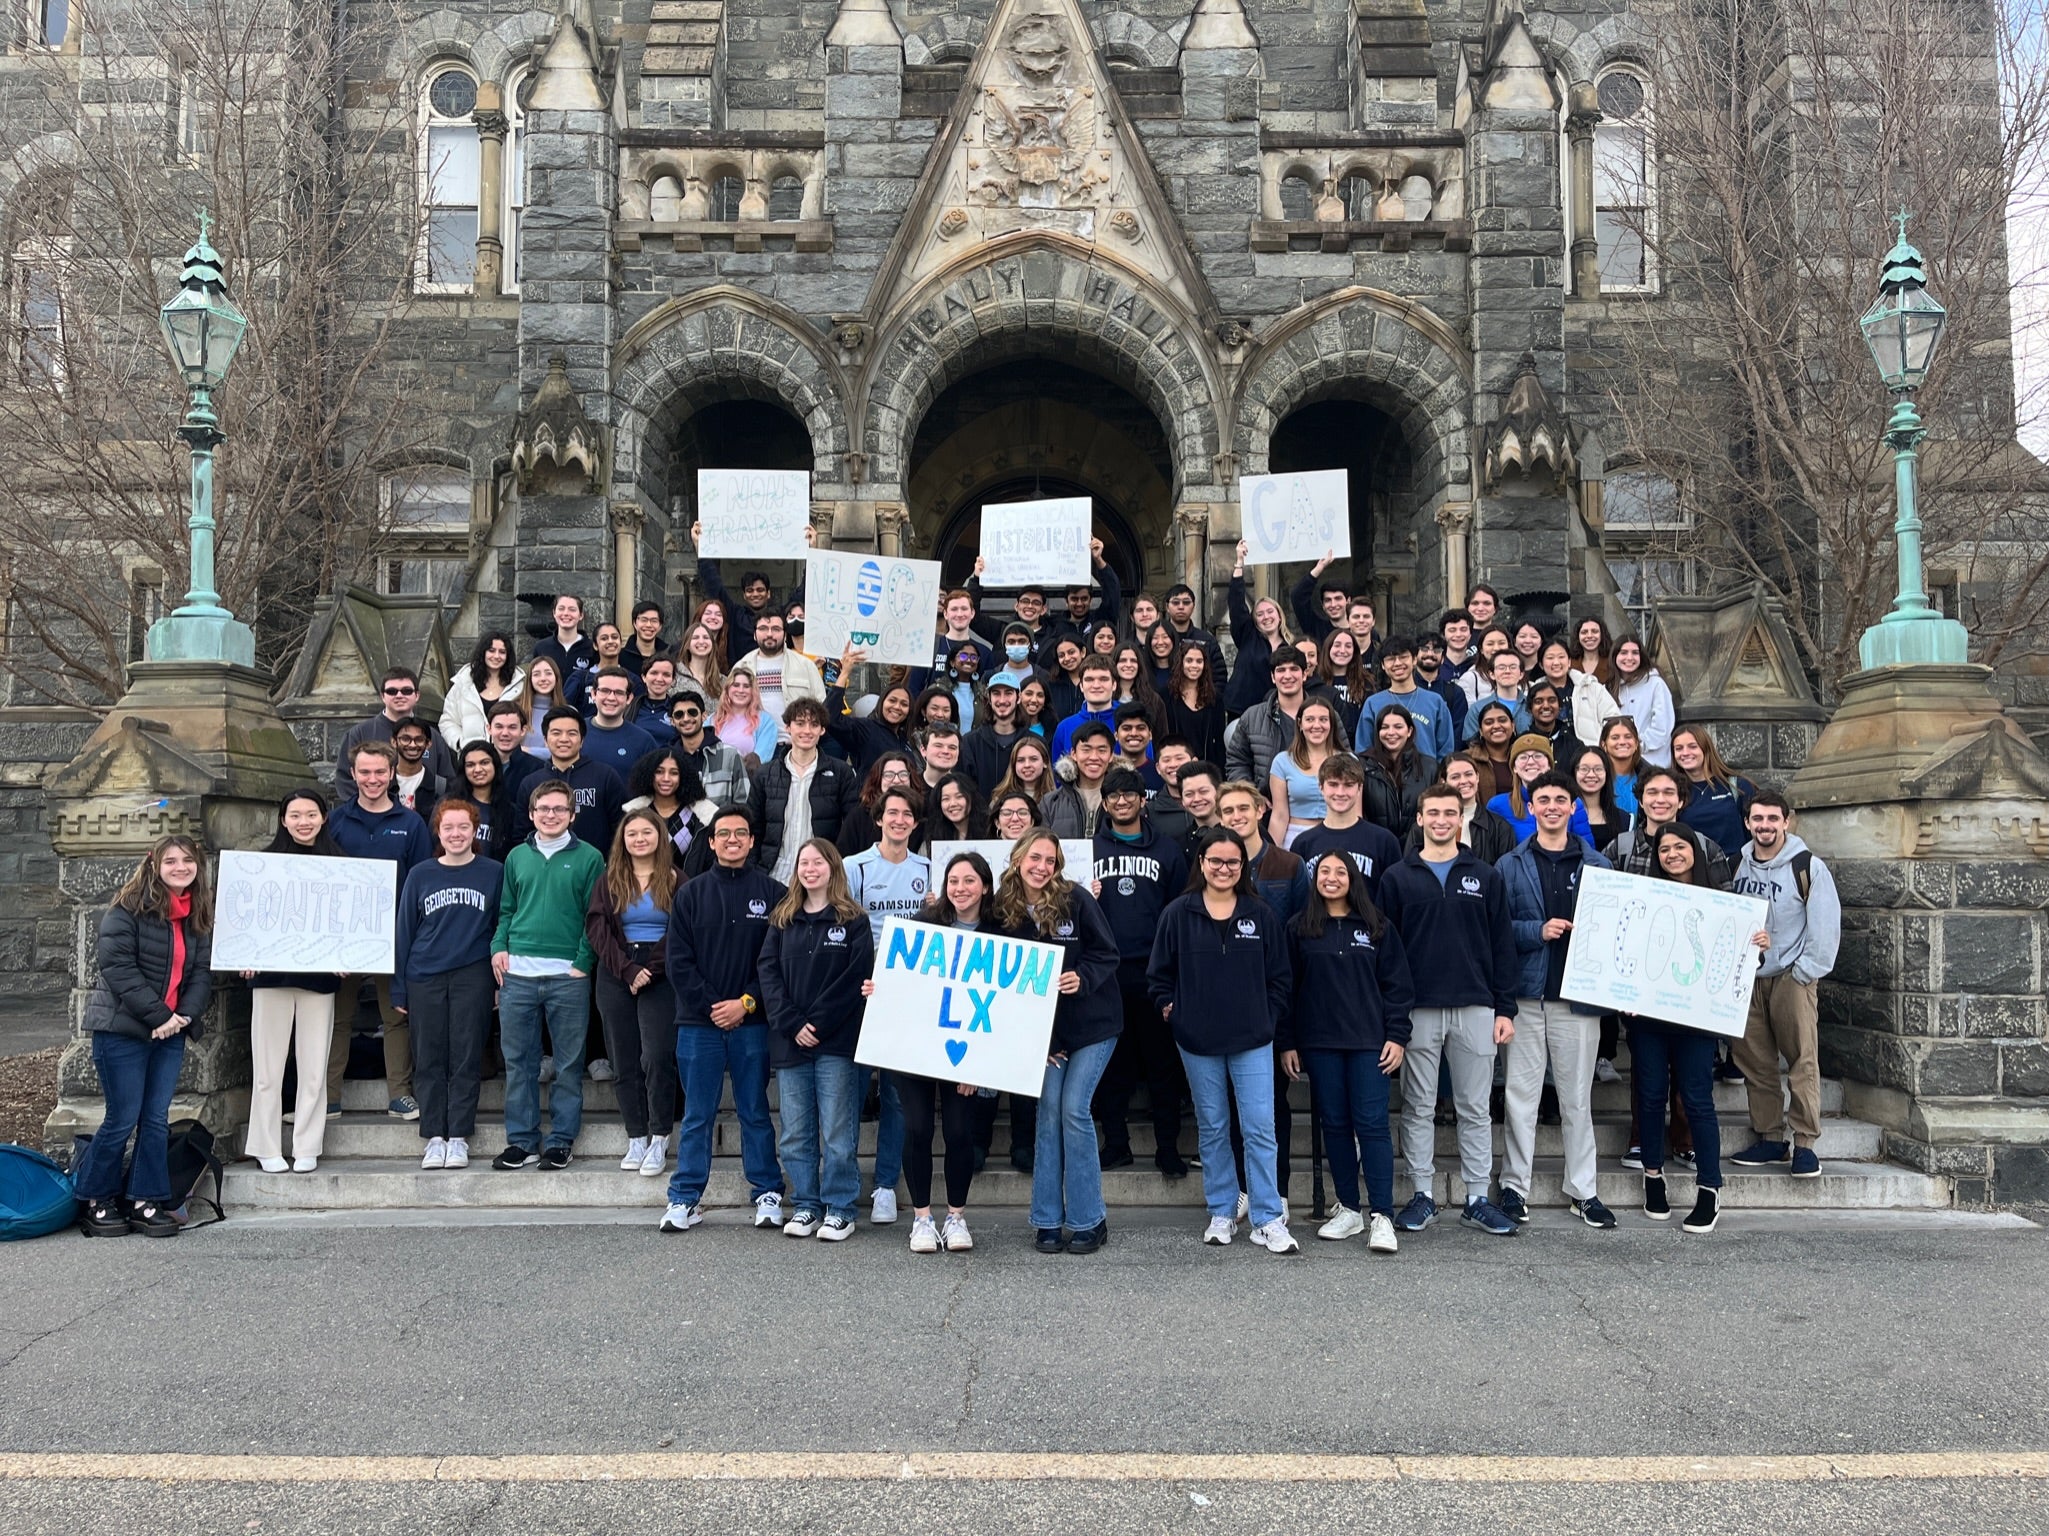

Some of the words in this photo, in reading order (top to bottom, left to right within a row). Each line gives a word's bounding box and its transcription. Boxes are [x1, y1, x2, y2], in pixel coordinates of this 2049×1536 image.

[896, 267, 1017, 357] HEALY
[1089, 279, 1178, 356] HALL
[702, 513, 784, 545] TRADS
[1251, 477, 1335, 552] GAs
[982, 526, 1085, 557] HISTORICAL
[1094, 855, 1160, 882] ILLINOIS
[225, 879, 394, 934] CONTEMP
[424, 887, 486, 916] GEORGETOWN
[885, 927, 1055, 997] NAIMUN
[938, 986, 997, 1033] LX
